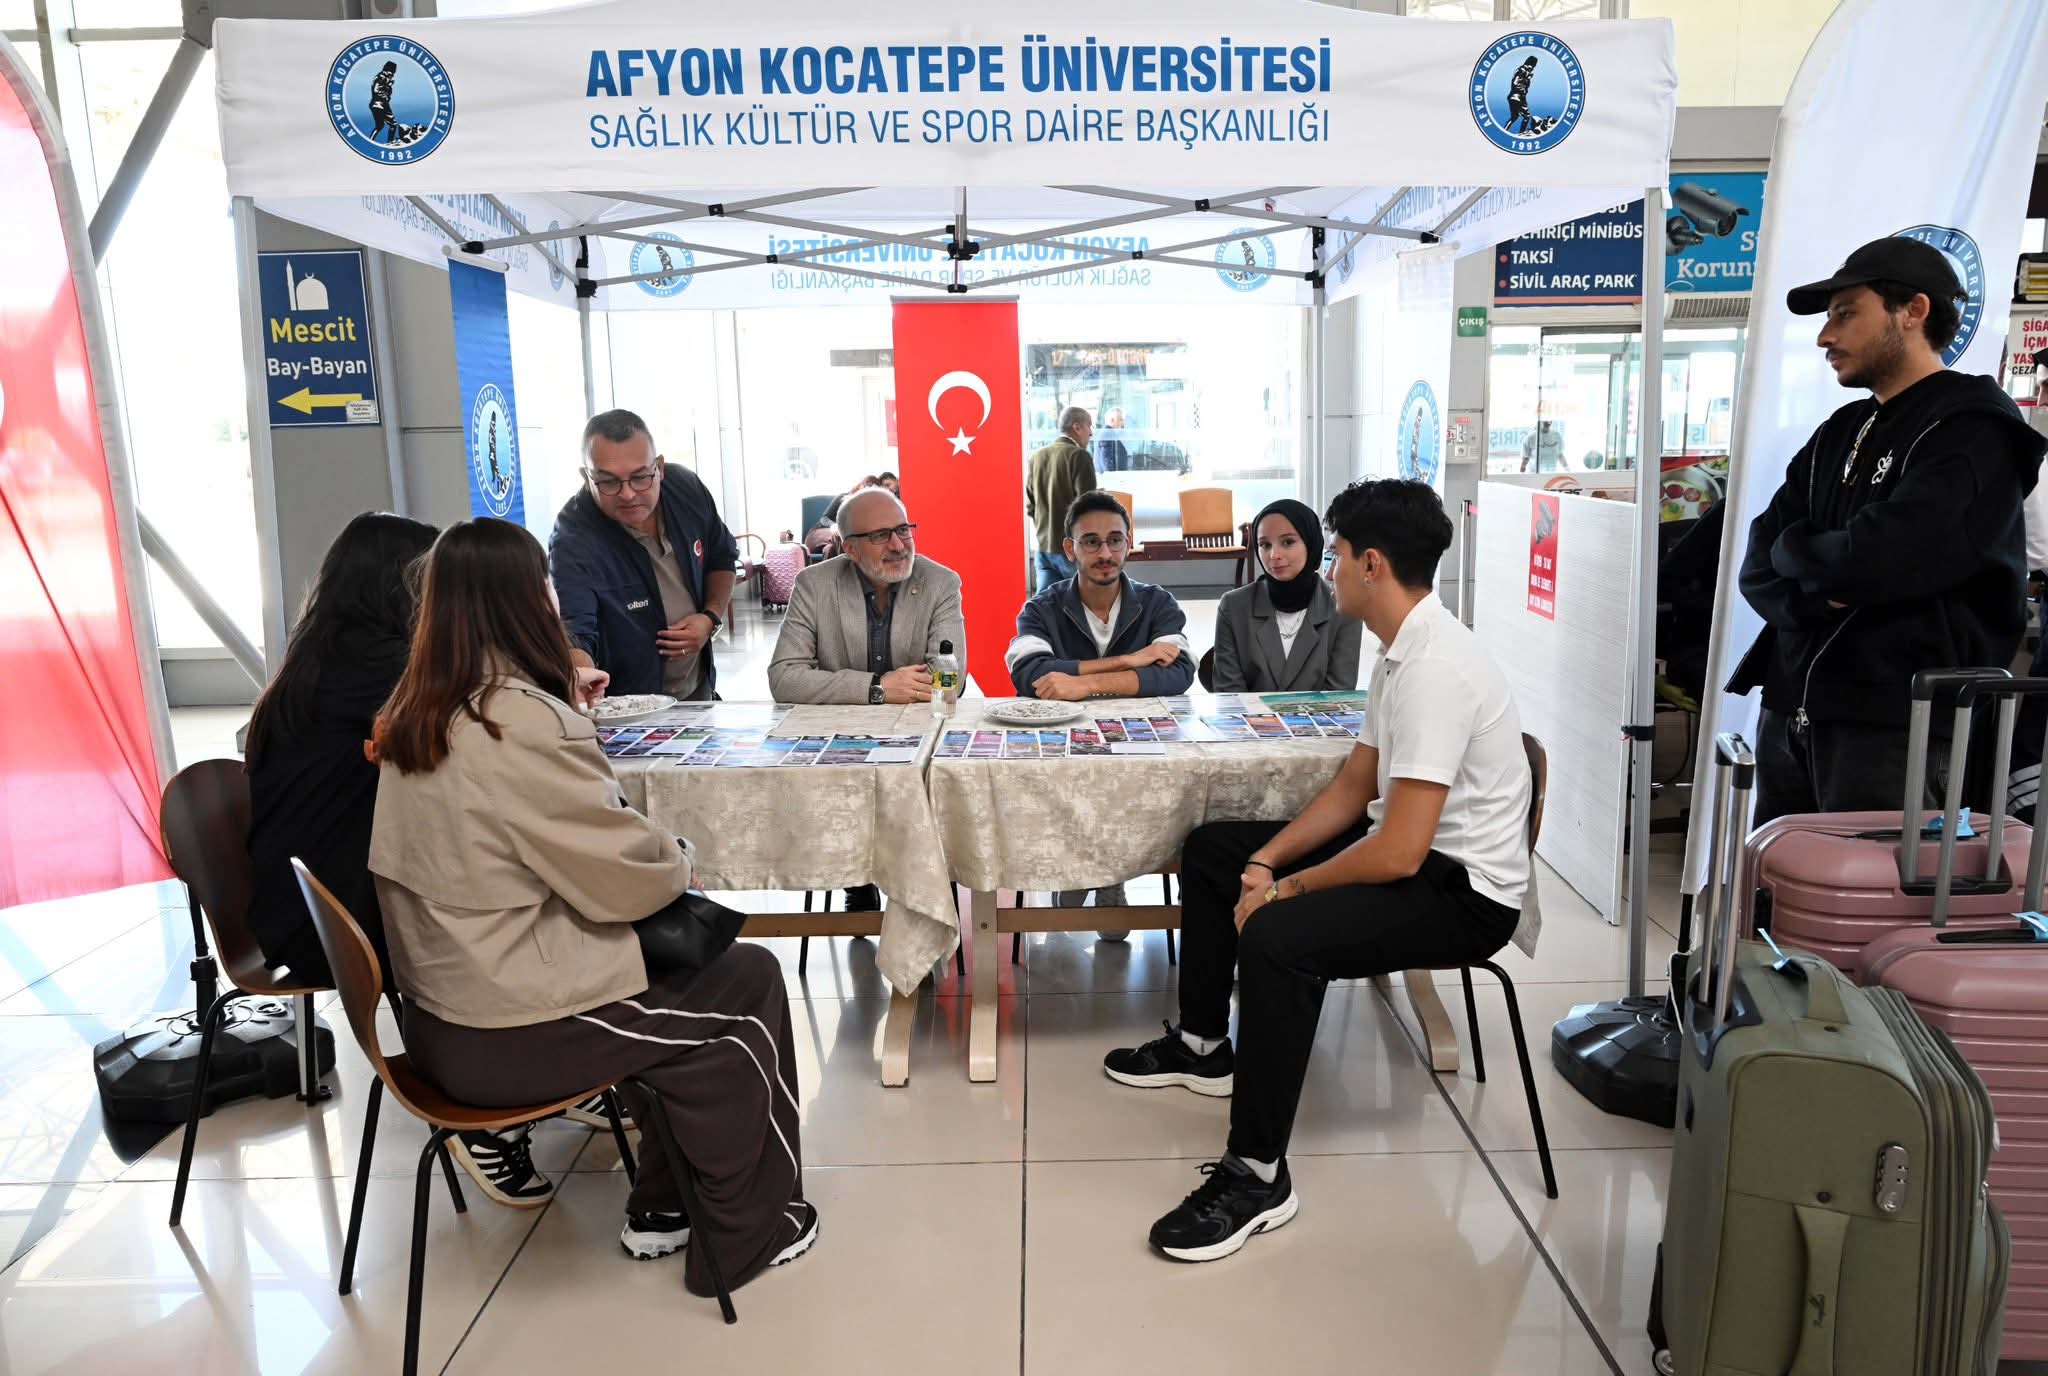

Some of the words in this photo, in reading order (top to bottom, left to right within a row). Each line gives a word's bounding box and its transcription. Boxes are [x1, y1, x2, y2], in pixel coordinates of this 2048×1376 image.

[333, 40, 390, 85] KOCATEPE
[585, 47, 744, 97] AFYON
[759, 45, 1005, 95] KOCATEPE
[1021, 34, 1331, 92] ÜNİVERSİTESİ
[1479, 36, 1535, 77] KOCATEPE
[399, 40, 450, 134] ÜNİVERSİTESİ
[1541, 37, 1582, 127] ÜNİVERSİTESİ
[332, 93, 356, 138] AFYON
[1474, 84, 1493, 127] AFYON
[590, 106, 714, 148] SAĞLIK
[726, 103, 857, 146] KÜLTÜR
[867, 110, 909, 143] VE
[922, 108, 1013, 144] SPOR
[1026, 103, 1124, 142] DAİRE
[1136, 102, 1329, 150] BAŞKANLIĞI
[380, 150, 412, 161] 1992
[1511, 140, 1541, 150] 1992
[1579, 221, 1643, 239] MİNİBÜS
[1511, 247, 1554, 264] TAKSİ
[1677, 258, 1755, 279] Korun
[1510, 272, 1547, 289] SİVİL
[1550, 274, 1590, 291] ARAÇ
[1594, 274, 1636, 288] PARK
[270, 316, 357, 343] Mescit
[1459, 317, 1485, 327] ÇIKIŞ
[267, 356, 368, 380] Bay-Bayan
